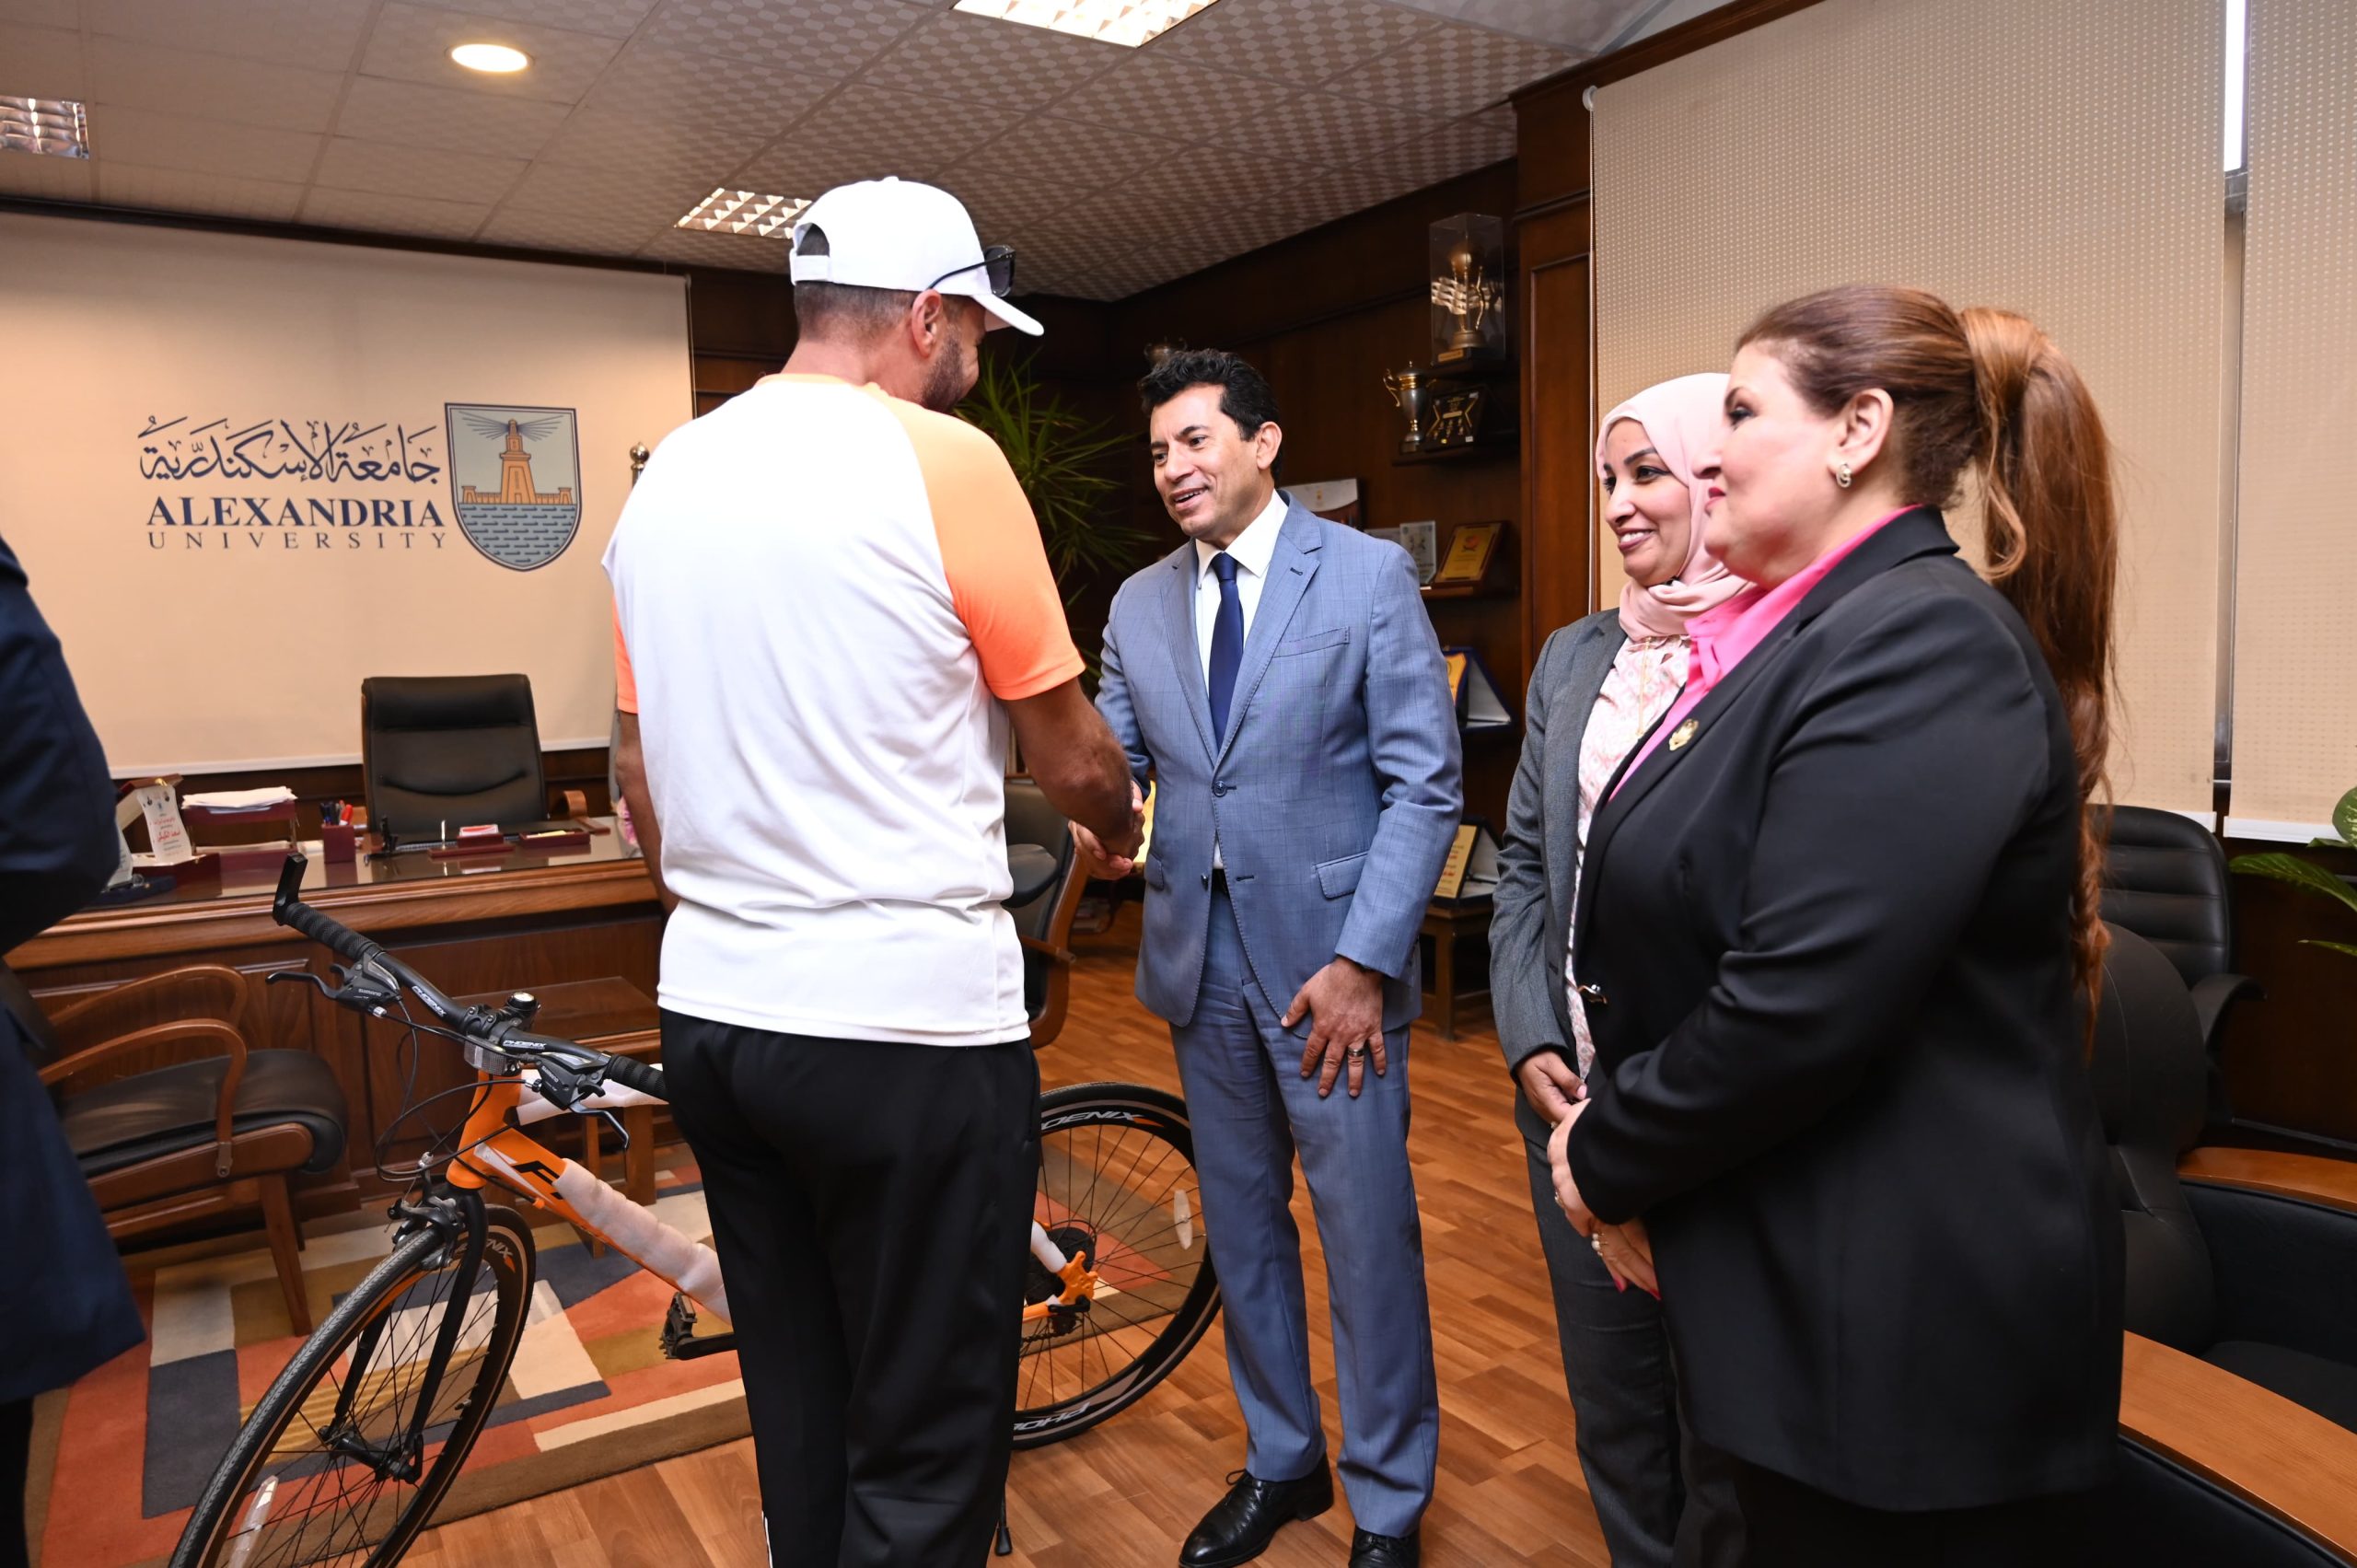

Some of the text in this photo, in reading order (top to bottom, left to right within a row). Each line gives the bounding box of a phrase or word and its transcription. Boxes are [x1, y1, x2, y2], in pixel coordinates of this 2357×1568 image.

[326, 423, 441, 484] جامعة
[146, 495, 445, 528] ALEXANDRIA
[148, 531, 446, 550] UNIVERSITY
[1041, 1110, 1144, 1131] OENIX
